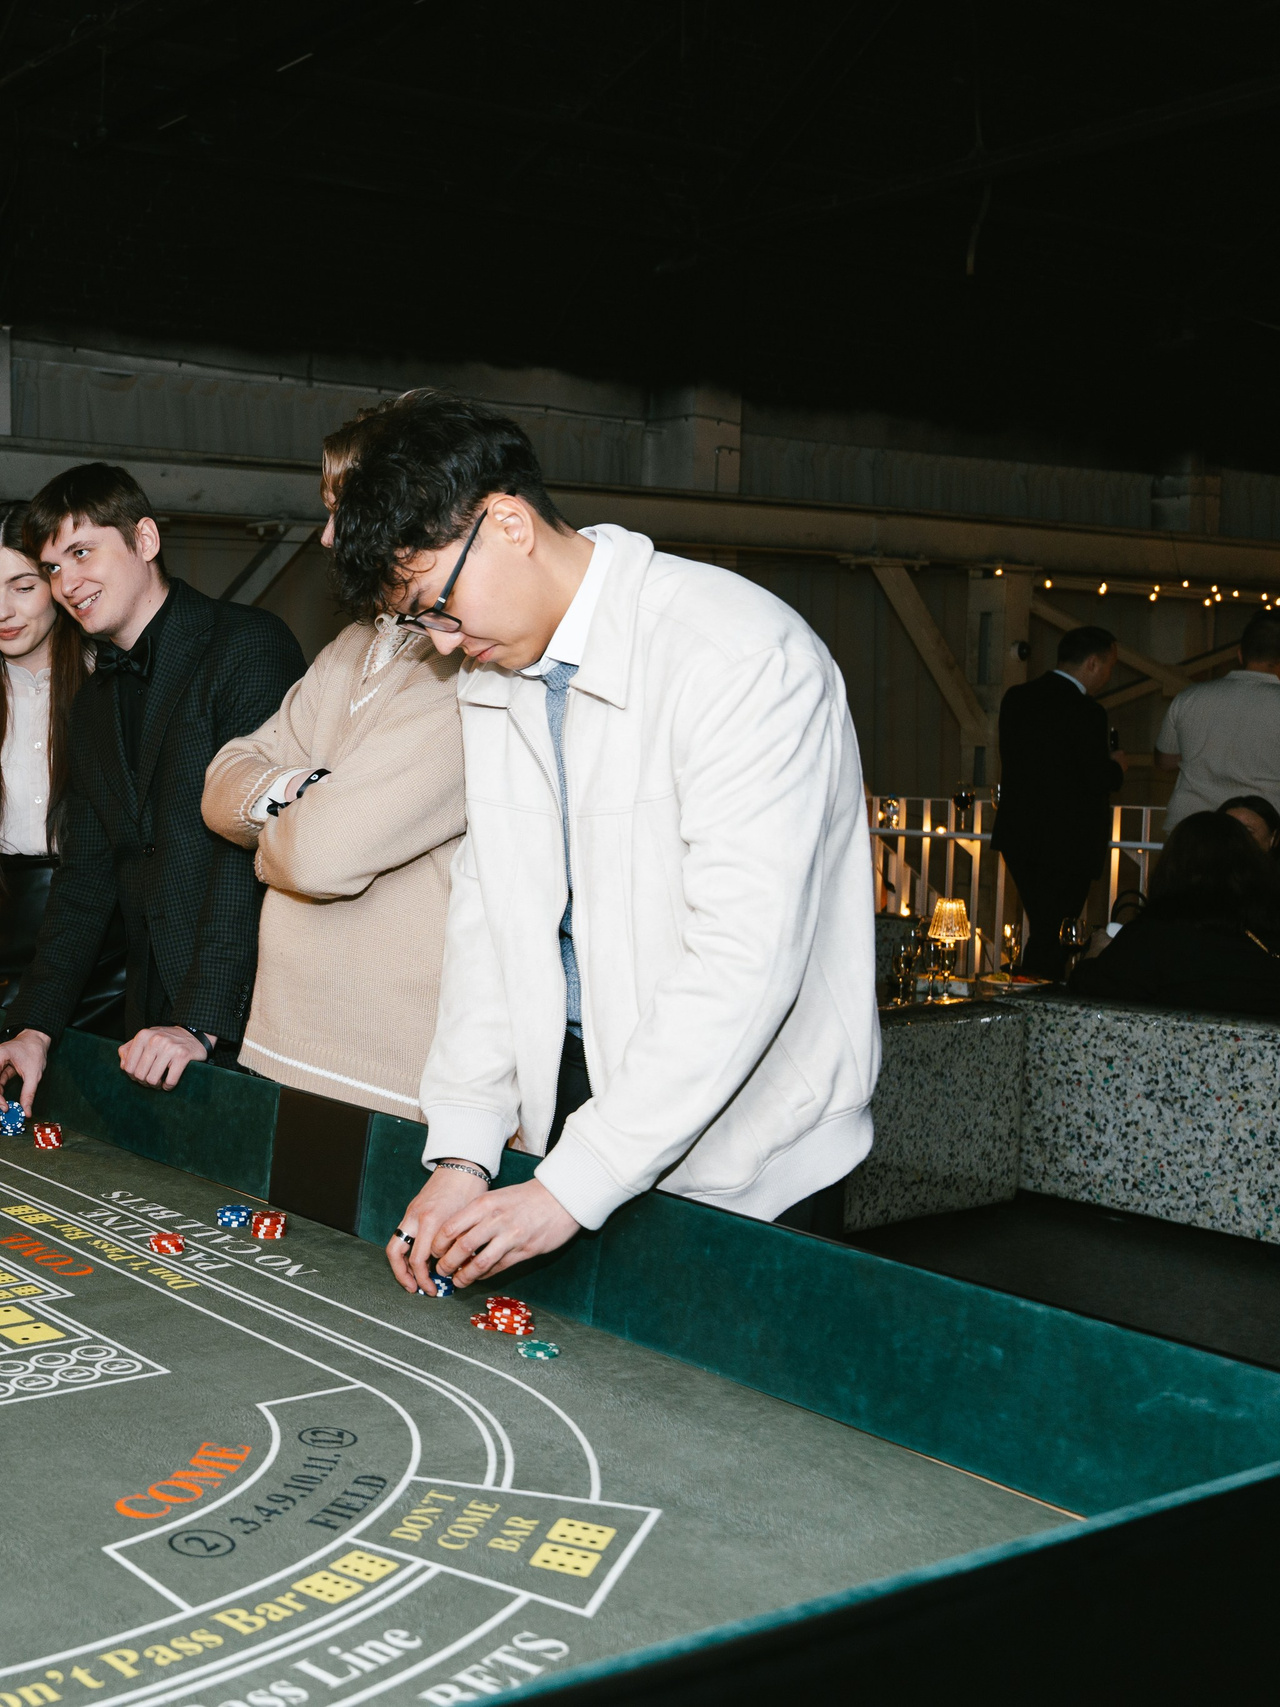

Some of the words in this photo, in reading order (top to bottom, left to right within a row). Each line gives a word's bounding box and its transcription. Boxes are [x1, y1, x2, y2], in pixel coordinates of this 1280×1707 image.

[77, 1208, 160, 1240] LINE
[101, 1190, 185, 1223] BETS
[50, 1221, 94, 1241] Bar
[174, 1219, 262, 1255] CALL
[86, 1238, 136, 1264] Pass
[255, 1254, 321, 1277] NO
[129, 1255, 202, 1290] Don't
[19, 1377, 48, 1387] E
[62, 1369, 91, 1379] E
[103, 1361, 132, 1371] E
[38, 1356, 66, 1365] C
[80, 1348, 108, 1358] C
[114, 1441, 252, 1519] COME
[305, 1474, 388, 1531] FIELD
[390, 1489, 456, 1542] DON'T
[437, 1499, 501, 1550] COME
[487, 1516, 540, 1553] BAR
[97, 1628, 224, 1679] Pass
[210, 1591, 306, 1636] Bar
[289, 1628, 423, 1690] Line
[417, 1630, 570, 1706] BETS
